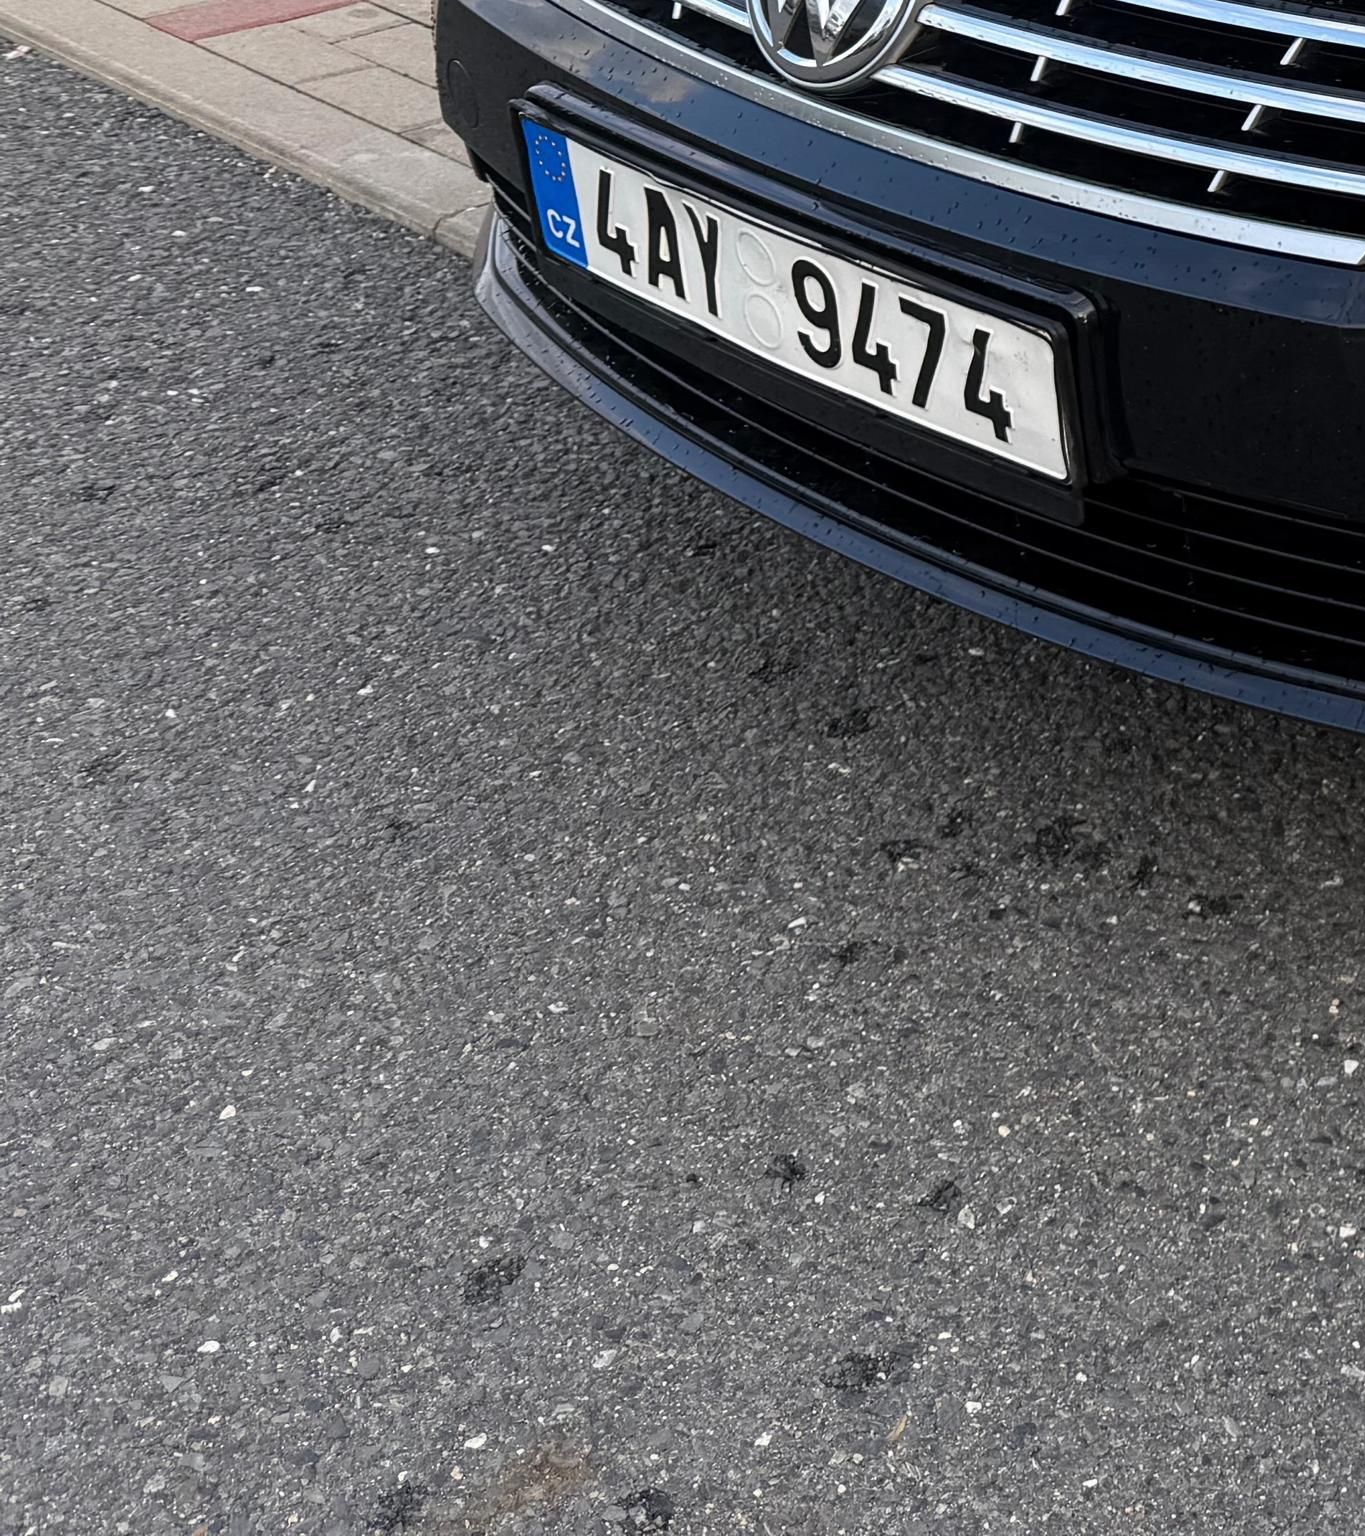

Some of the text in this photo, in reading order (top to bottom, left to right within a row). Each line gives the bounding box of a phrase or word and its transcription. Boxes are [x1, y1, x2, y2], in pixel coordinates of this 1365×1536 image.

[546, 208, 581, 248] CZ
[597, 168, 1011, 444] 4AY 9474
